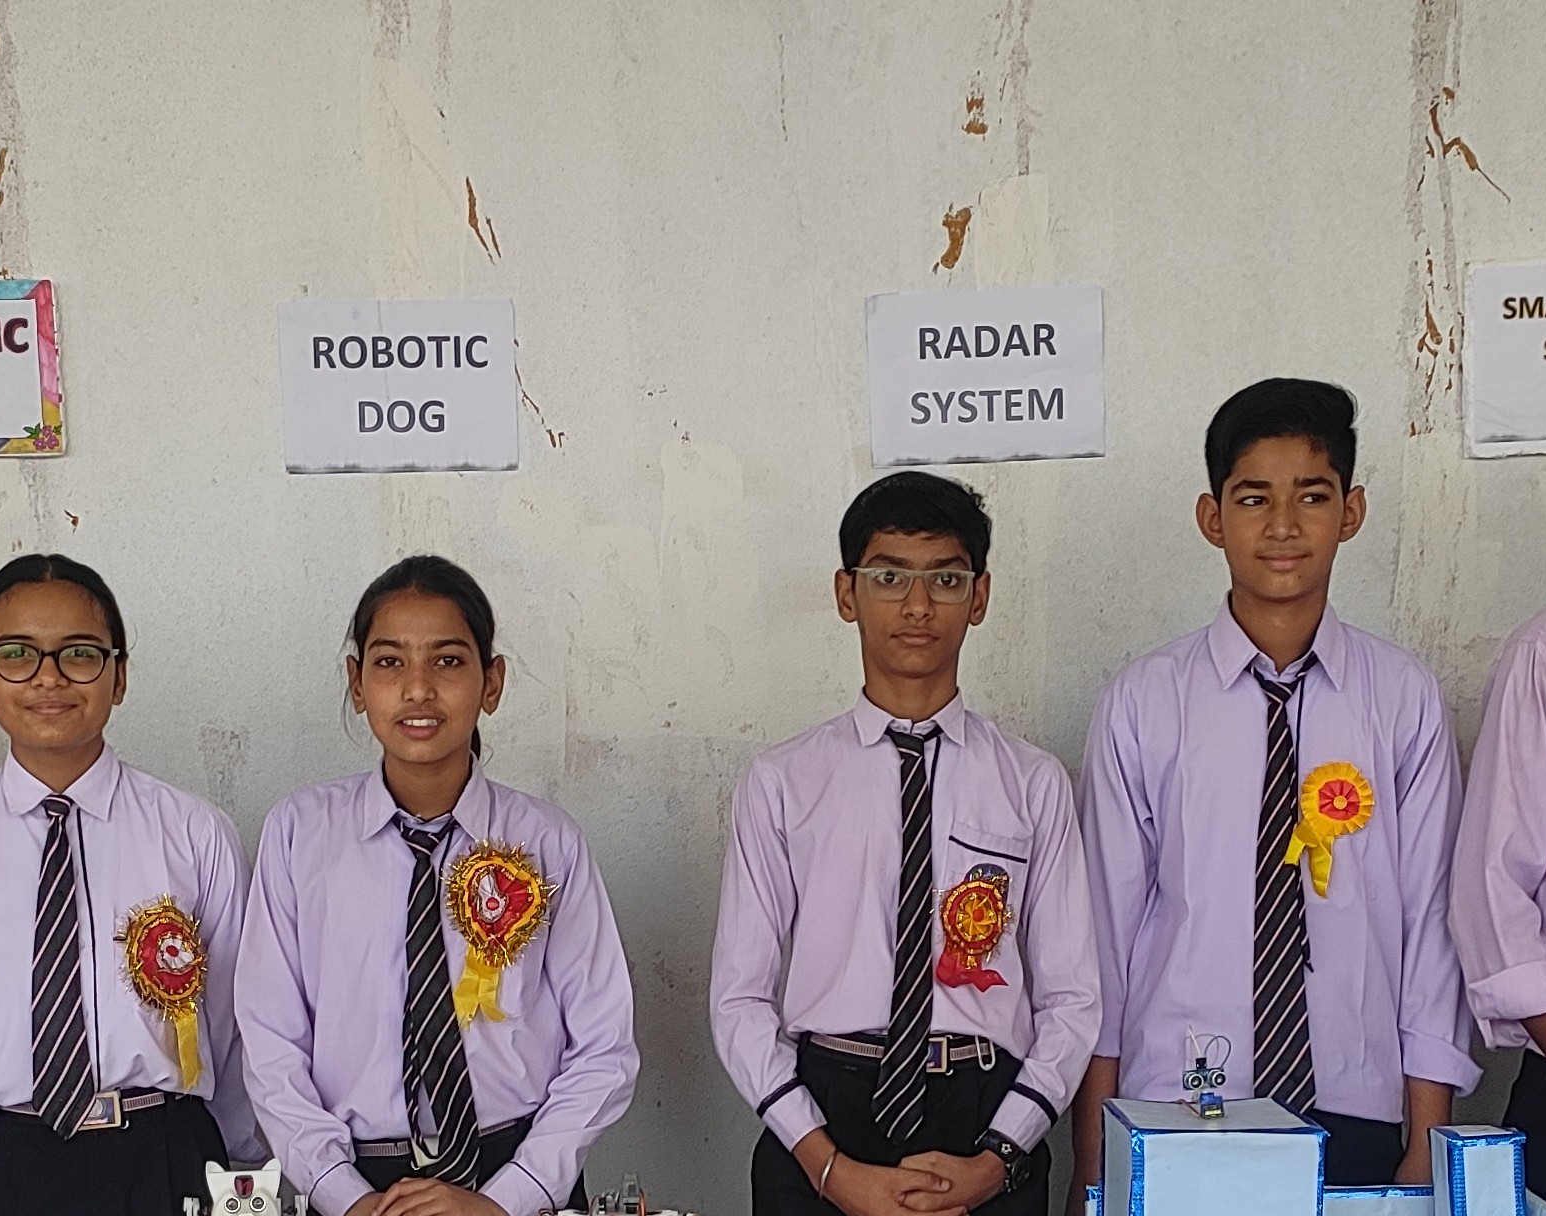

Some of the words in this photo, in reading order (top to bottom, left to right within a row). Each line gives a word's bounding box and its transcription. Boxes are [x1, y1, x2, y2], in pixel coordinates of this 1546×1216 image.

[312, 335, 489, 369] ROBOTIC
[918, 323, 1057, 360] RADAR
[358, 400, 445, 433] DOG
[910, 387, 1064, 424] SYSTEM
